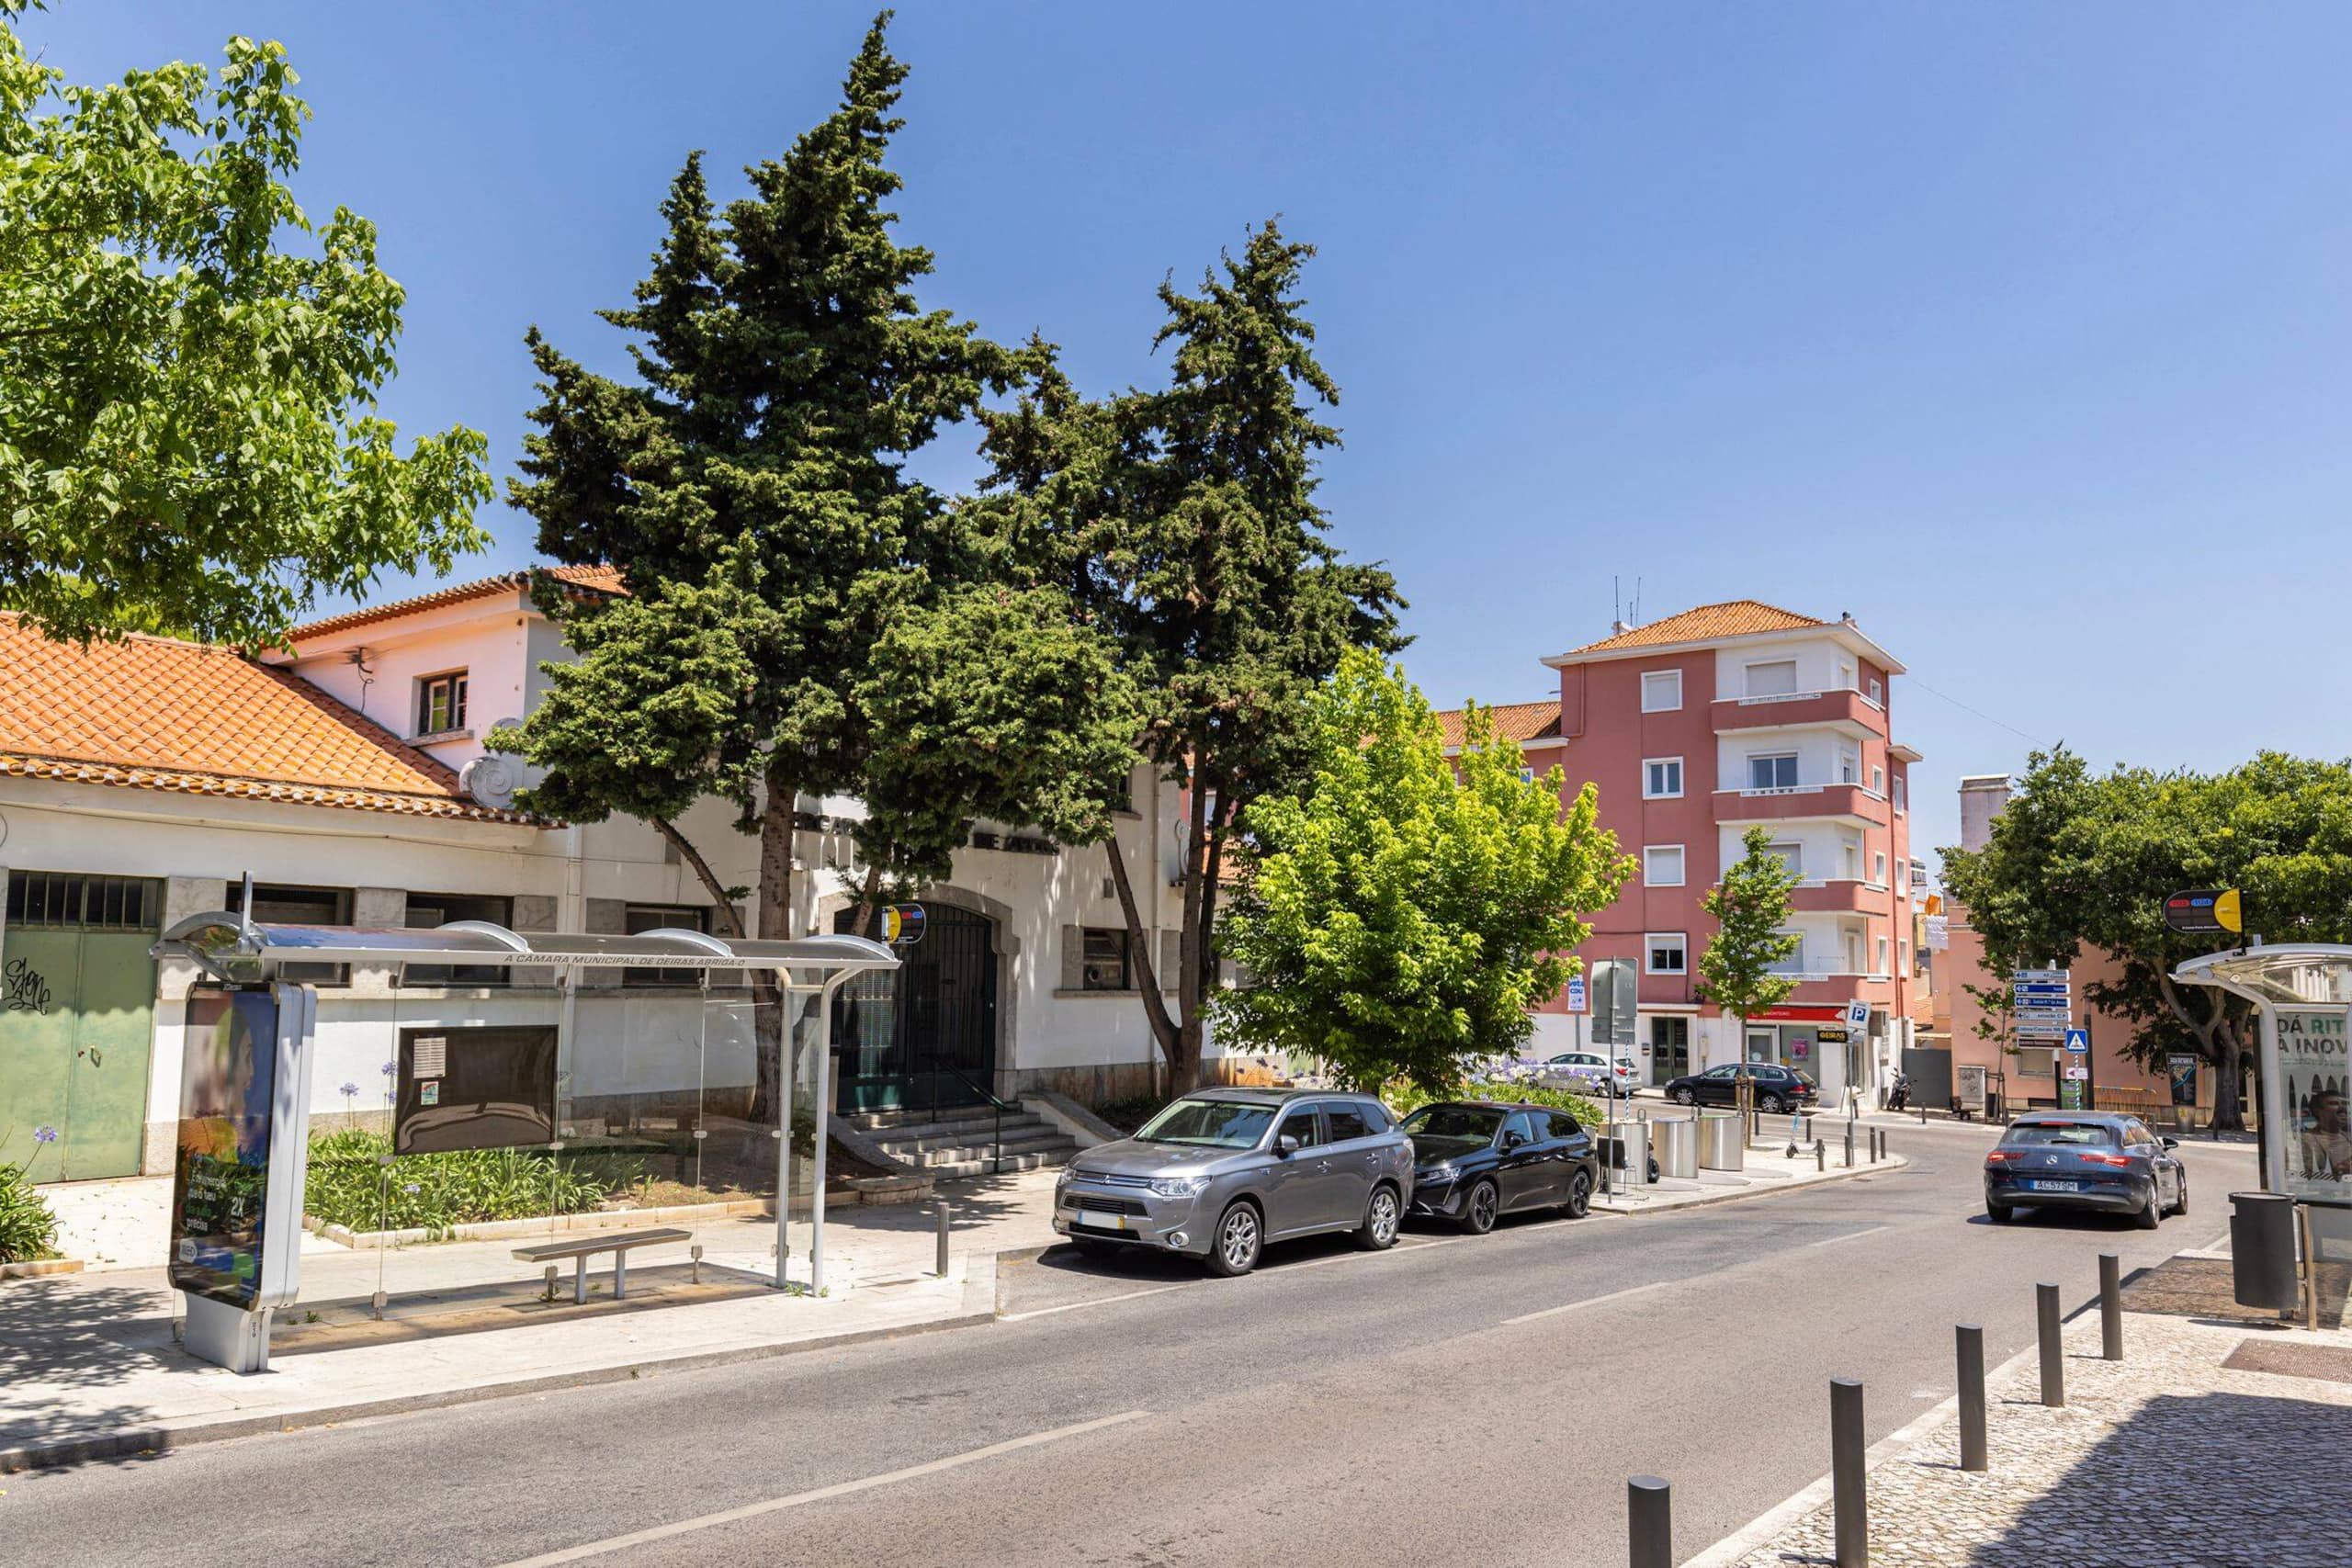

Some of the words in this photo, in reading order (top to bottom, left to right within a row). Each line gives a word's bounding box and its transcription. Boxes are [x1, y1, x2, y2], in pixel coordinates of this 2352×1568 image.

[572, 955, 635, 964] MUNICIPAL
[639, 956, 653, 965] DE
[657, 956, 695, 965] OEIRAS
[697, 957, 745, 966] ABRIGA-O
[2278, 1015, 2304, 1033] DÁ
[231, 1196, 246, 1218] 2X
